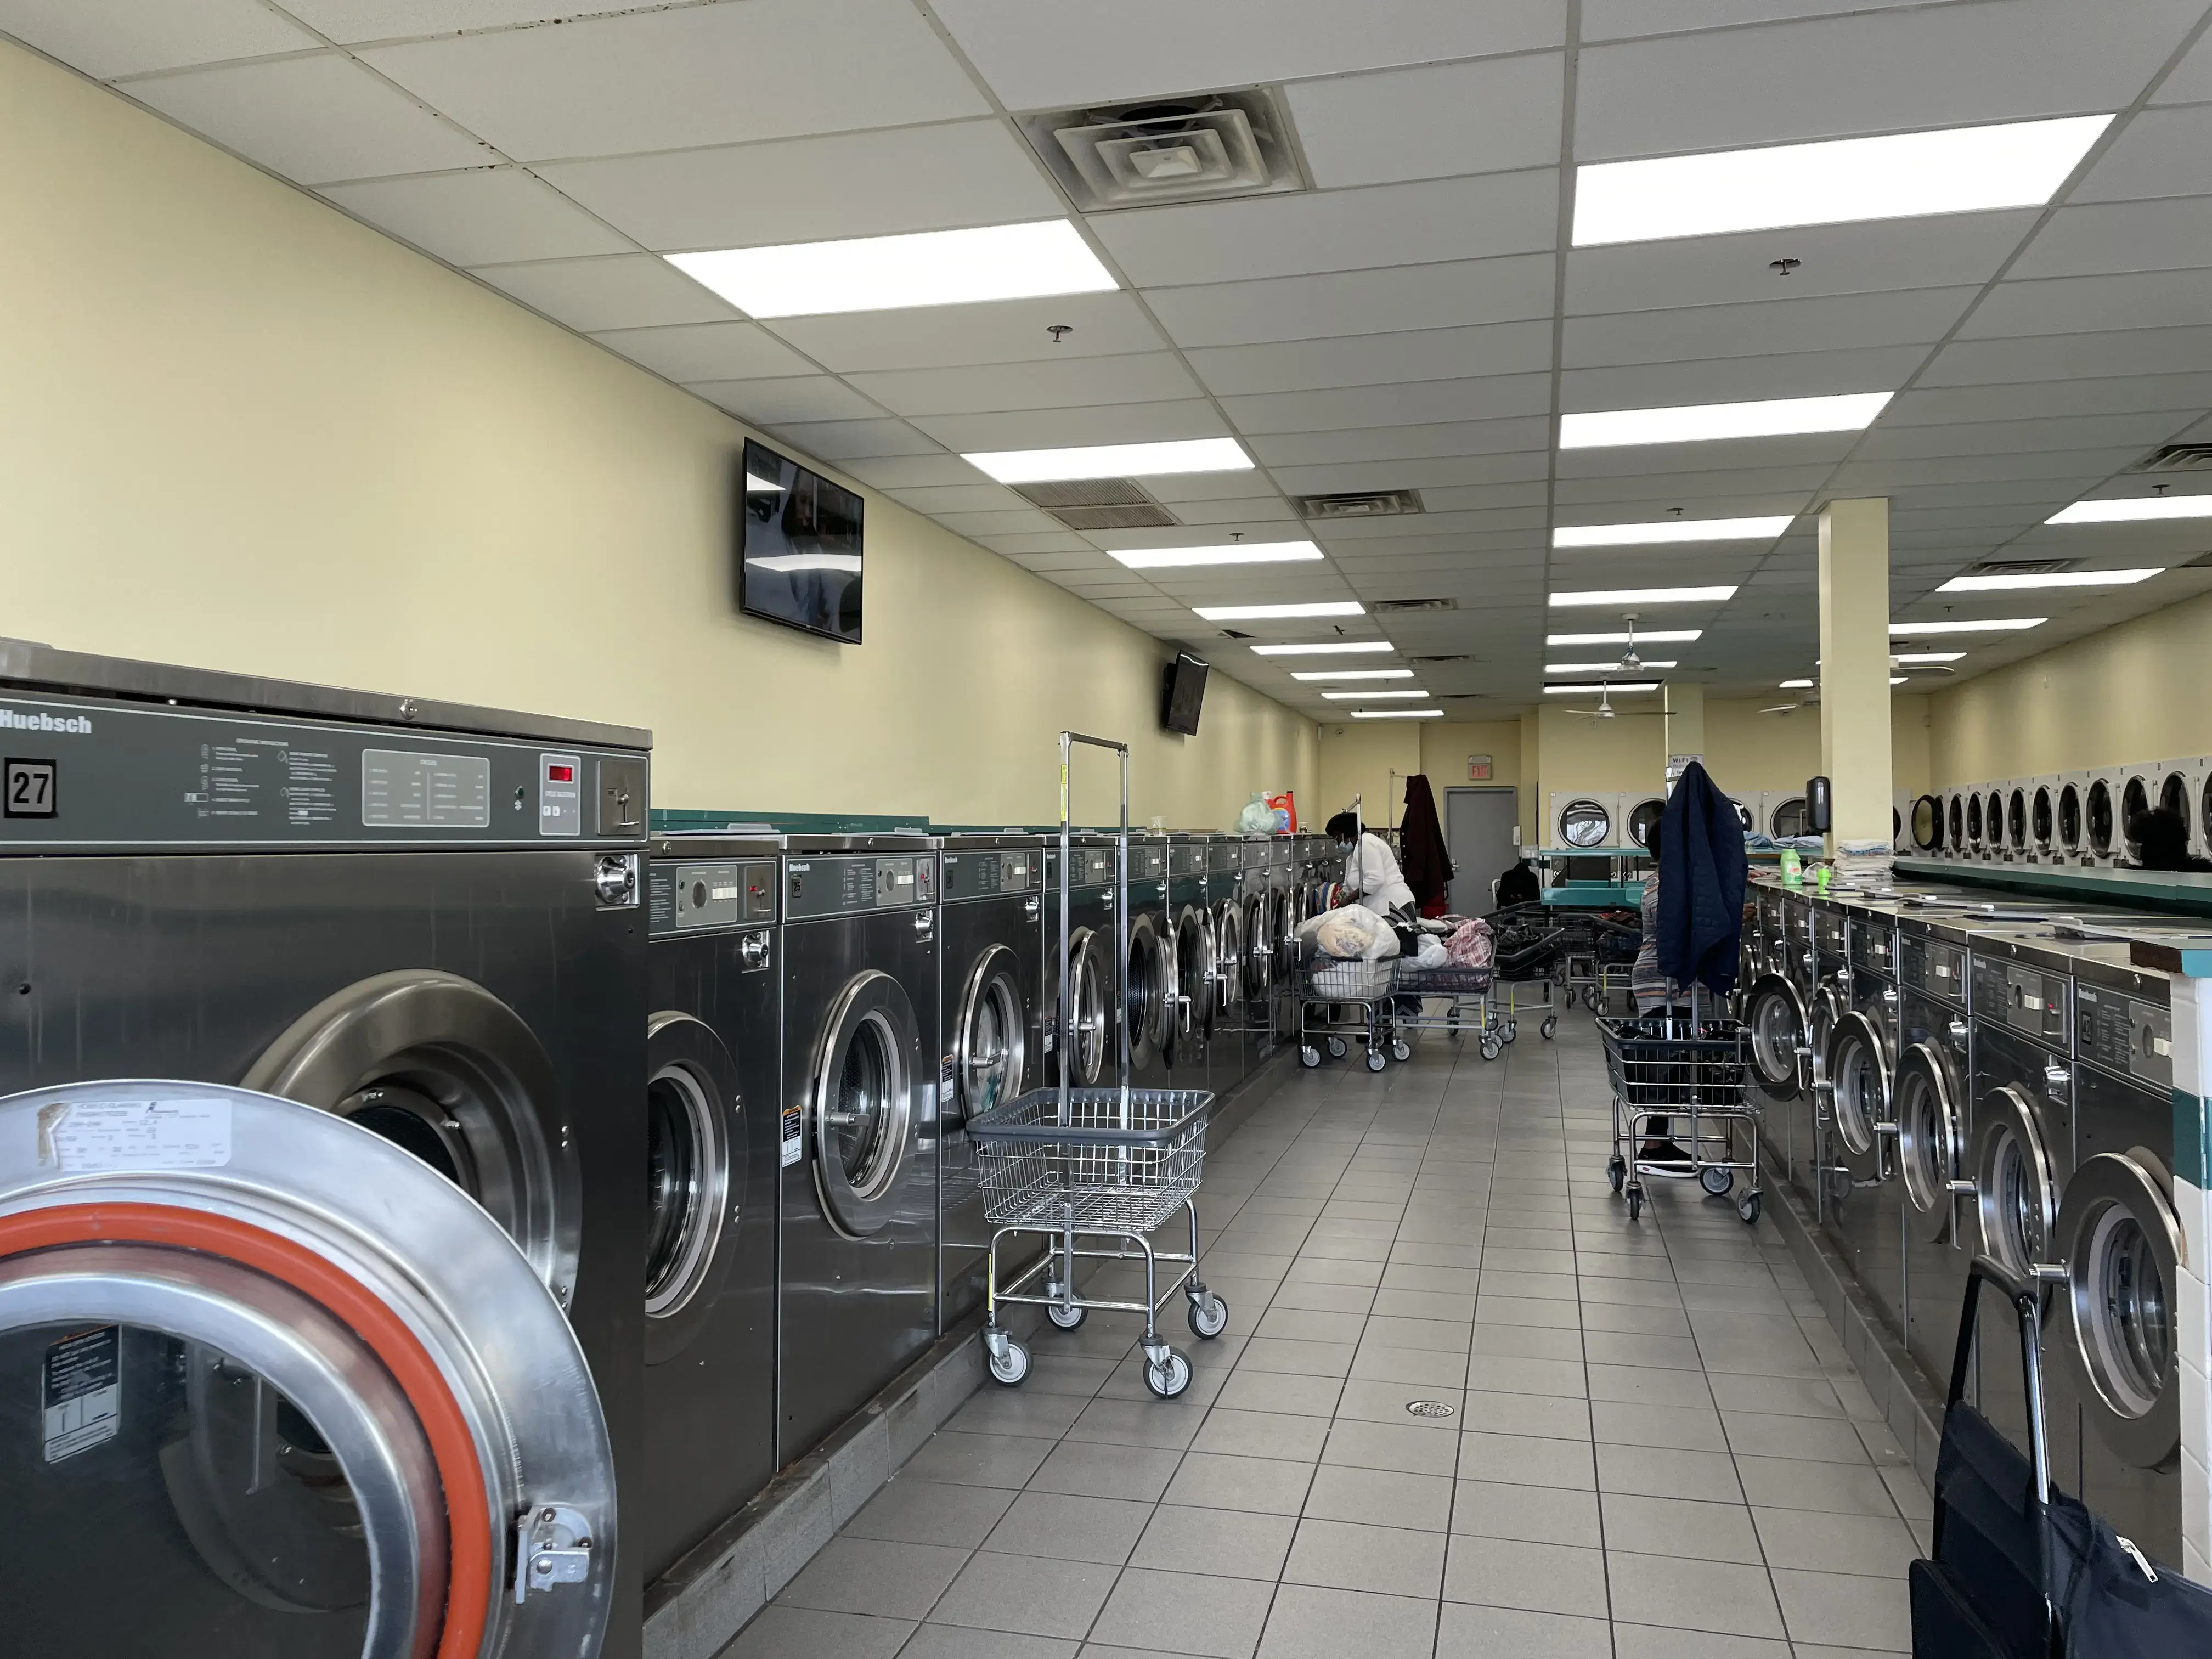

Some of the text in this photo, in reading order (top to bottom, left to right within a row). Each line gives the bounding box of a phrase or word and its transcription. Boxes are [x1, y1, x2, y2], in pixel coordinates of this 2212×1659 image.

[0, 709, 92, 733] Huebsch
[1472, 765, 1488, 778] EXIT
[13, 772, 49, 804] 27
[793, 881, 800, 891] 25
